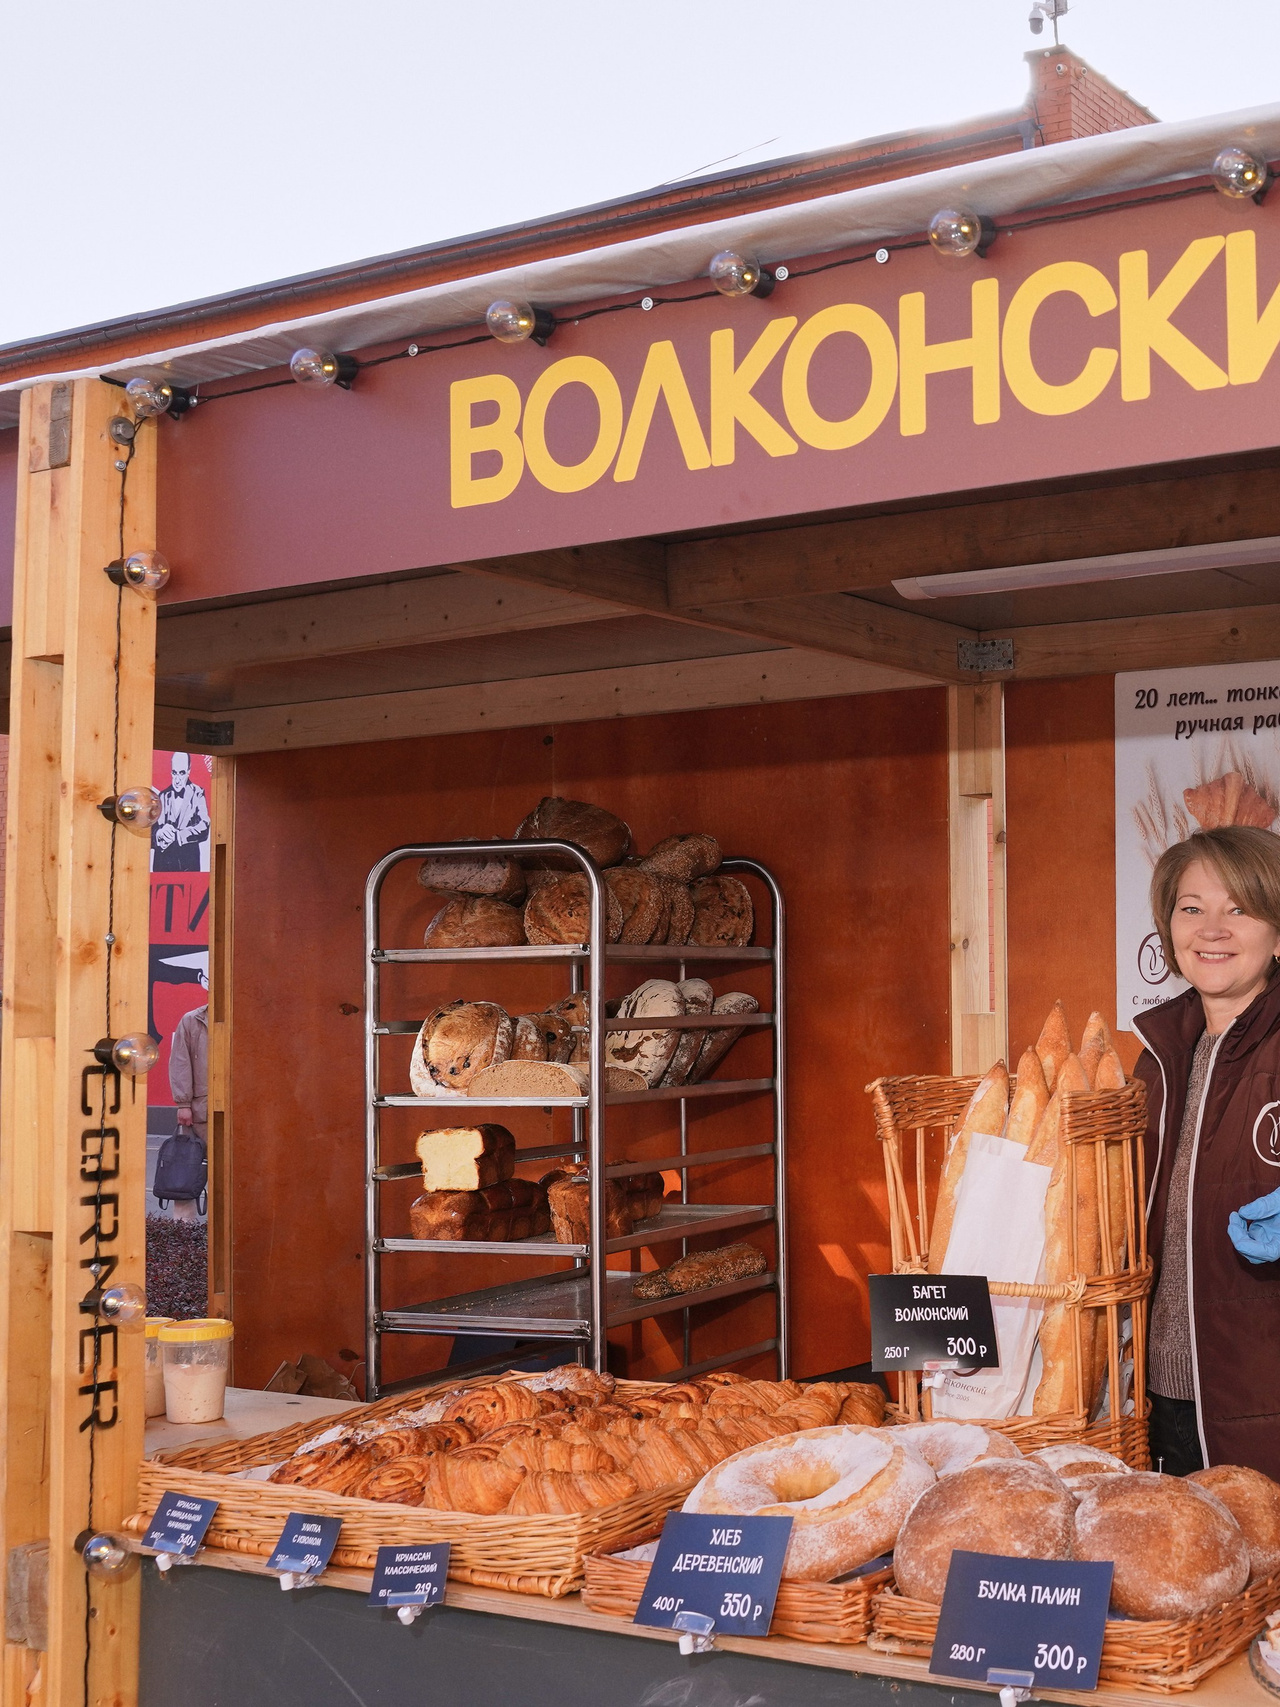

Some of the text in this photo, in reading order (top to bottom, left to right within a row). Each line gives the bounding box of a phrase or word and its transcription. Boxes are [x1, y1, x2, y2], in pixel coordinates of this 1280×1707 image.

[1134, 688, 1158, 709] 20
[1166, 691, 1218, 707] лет...
[1174, 714, 1244, 740] ручная
[1132, 995, 1139, 1005] С
[79, 1064, 119, 1435] CORNER
[912, 1285, 946, 1299] БАГЕТ
[894, 1305, 969, 1322] ВОЛКОНСКИЙ
[884, 1346, 902, 1359] 250
[947, 1337, 976, 1356] 300
[176, 1532, 194, 1547] 340
[292, 1534, 298, 1543] С
[710, 1528, 743, 1546] ХЛЕБ
[301, 1554, 319, 1566] 260
[395, 1551, 431, 1562] КРУАССАН
[671, 1553, 764, 1575] ДЕРЕВЕНСКИЙ
[384, 1562, 438, 1575] КЛАССИЧЕСКИЙ
[414, 1582, 432, 1595] 219
[977, 1580, 1081, 1606] БУЛКА ПАЛИН
[652, 1596, 674, 1611] 400
[720, 1592, 752, 1618] 350
[949, 1643, 975, 1662] 280
[1034, 1643, 1074, 1671] 300
